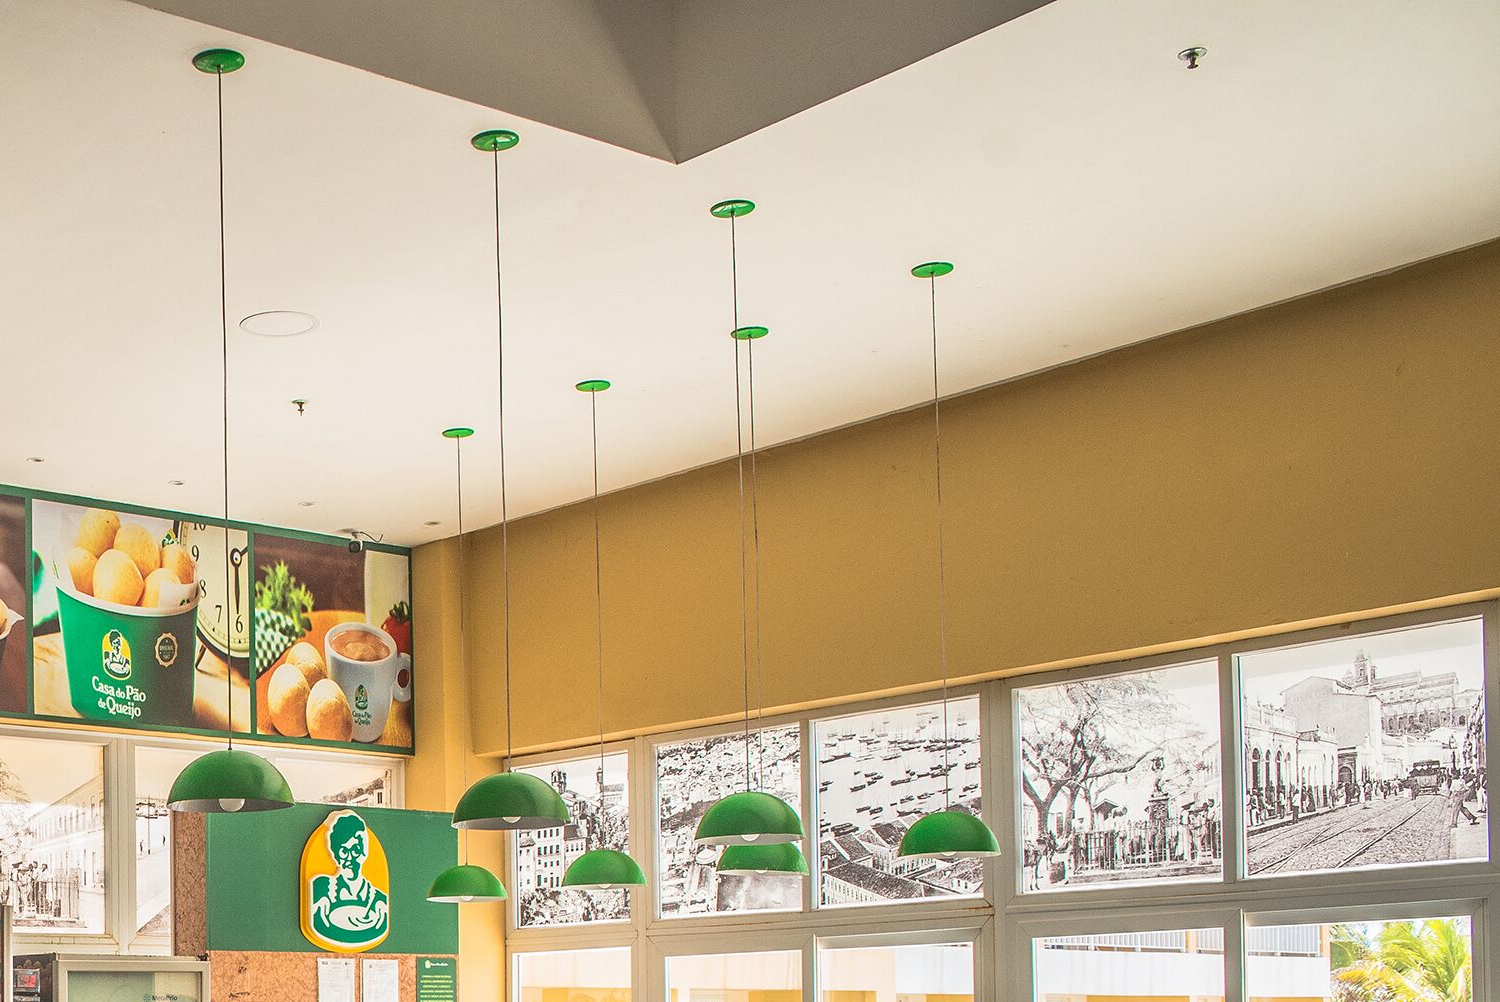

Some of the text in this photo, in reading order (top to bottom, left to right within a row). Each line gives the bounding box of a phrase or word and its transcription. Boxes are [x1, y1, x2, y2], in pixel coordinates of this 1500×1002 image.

[191, 545, 200, 562] 9
[199, 579, 207, 598] 8
[215, 605, 222, 623] 7
[235, 614, 243, 633] 6
[91, 675, 147, 702] Casa do Pão
[97, 696, 142, 719] de Queijo
